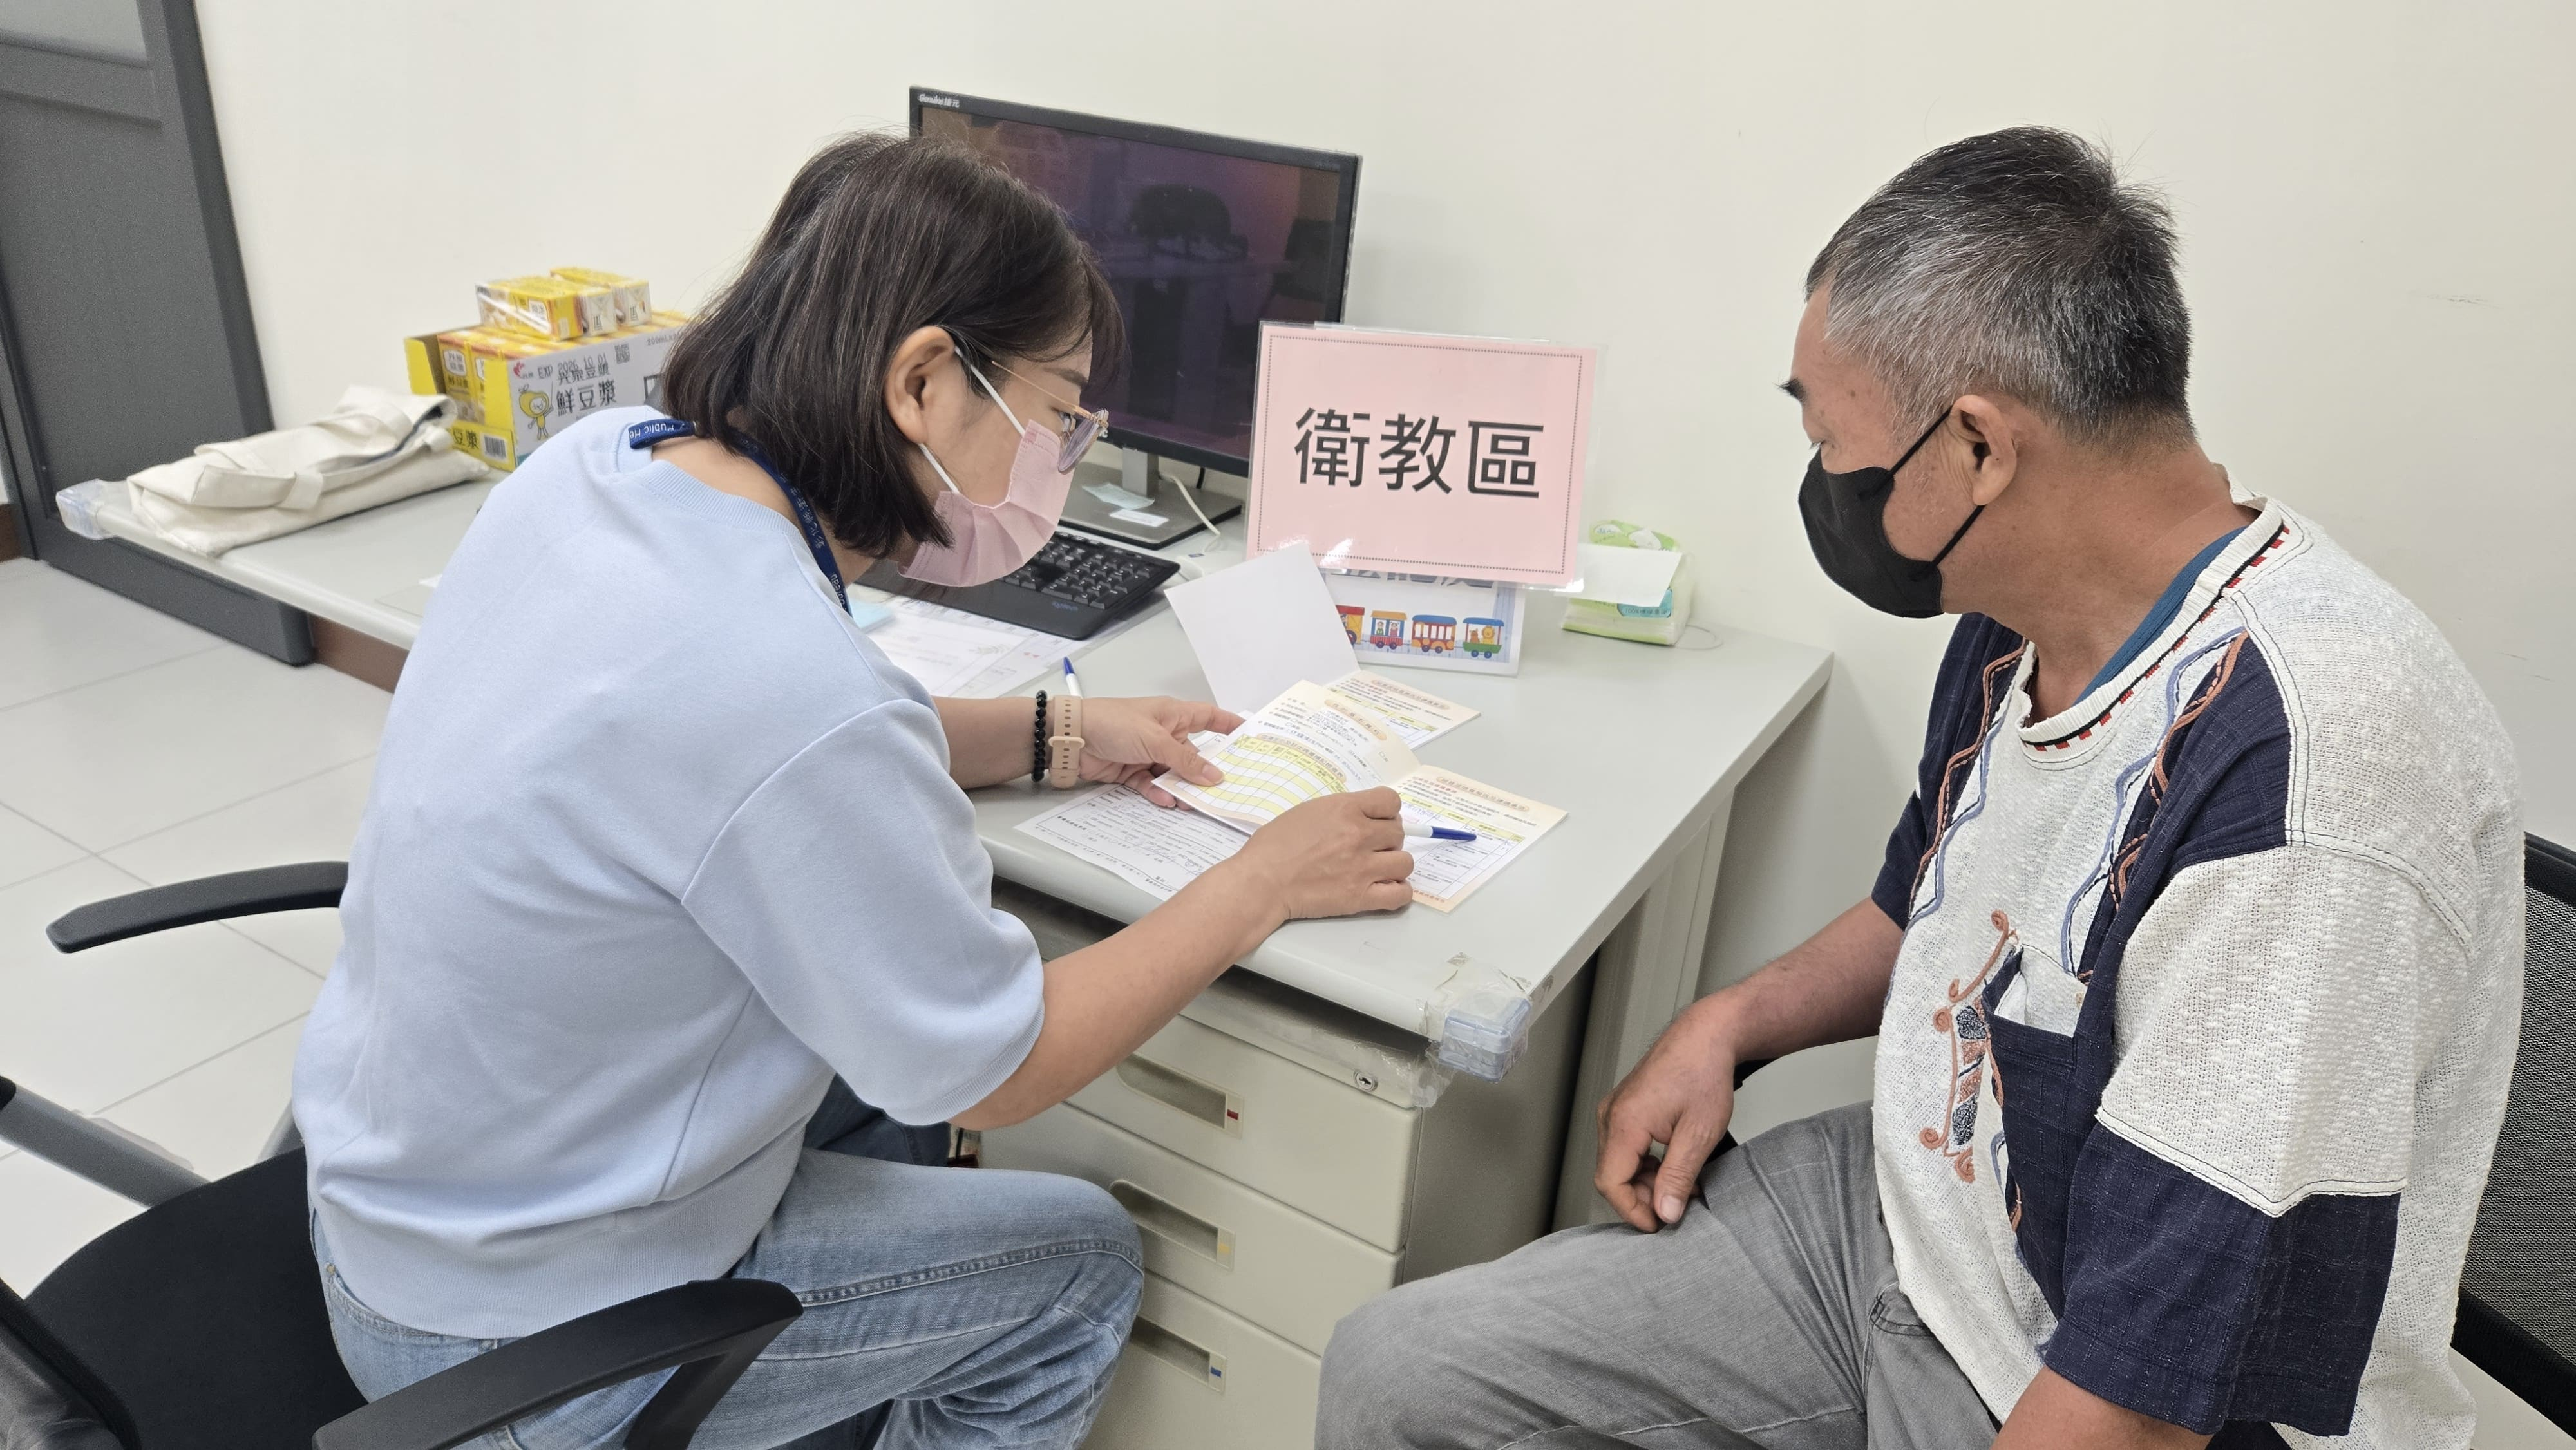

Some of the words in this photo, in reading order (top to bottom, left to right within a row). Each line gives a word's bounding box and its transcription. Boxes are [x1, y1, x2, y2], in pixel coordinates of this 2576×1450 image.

[537, 364, 554, 379] EXP
[558, 358, 579, 375] 2026
[583, 355, 594, 370] 10
[556, 378, 617, 417] 鮮豆漿
[1294, 407, 1544, 499] 衛教區
